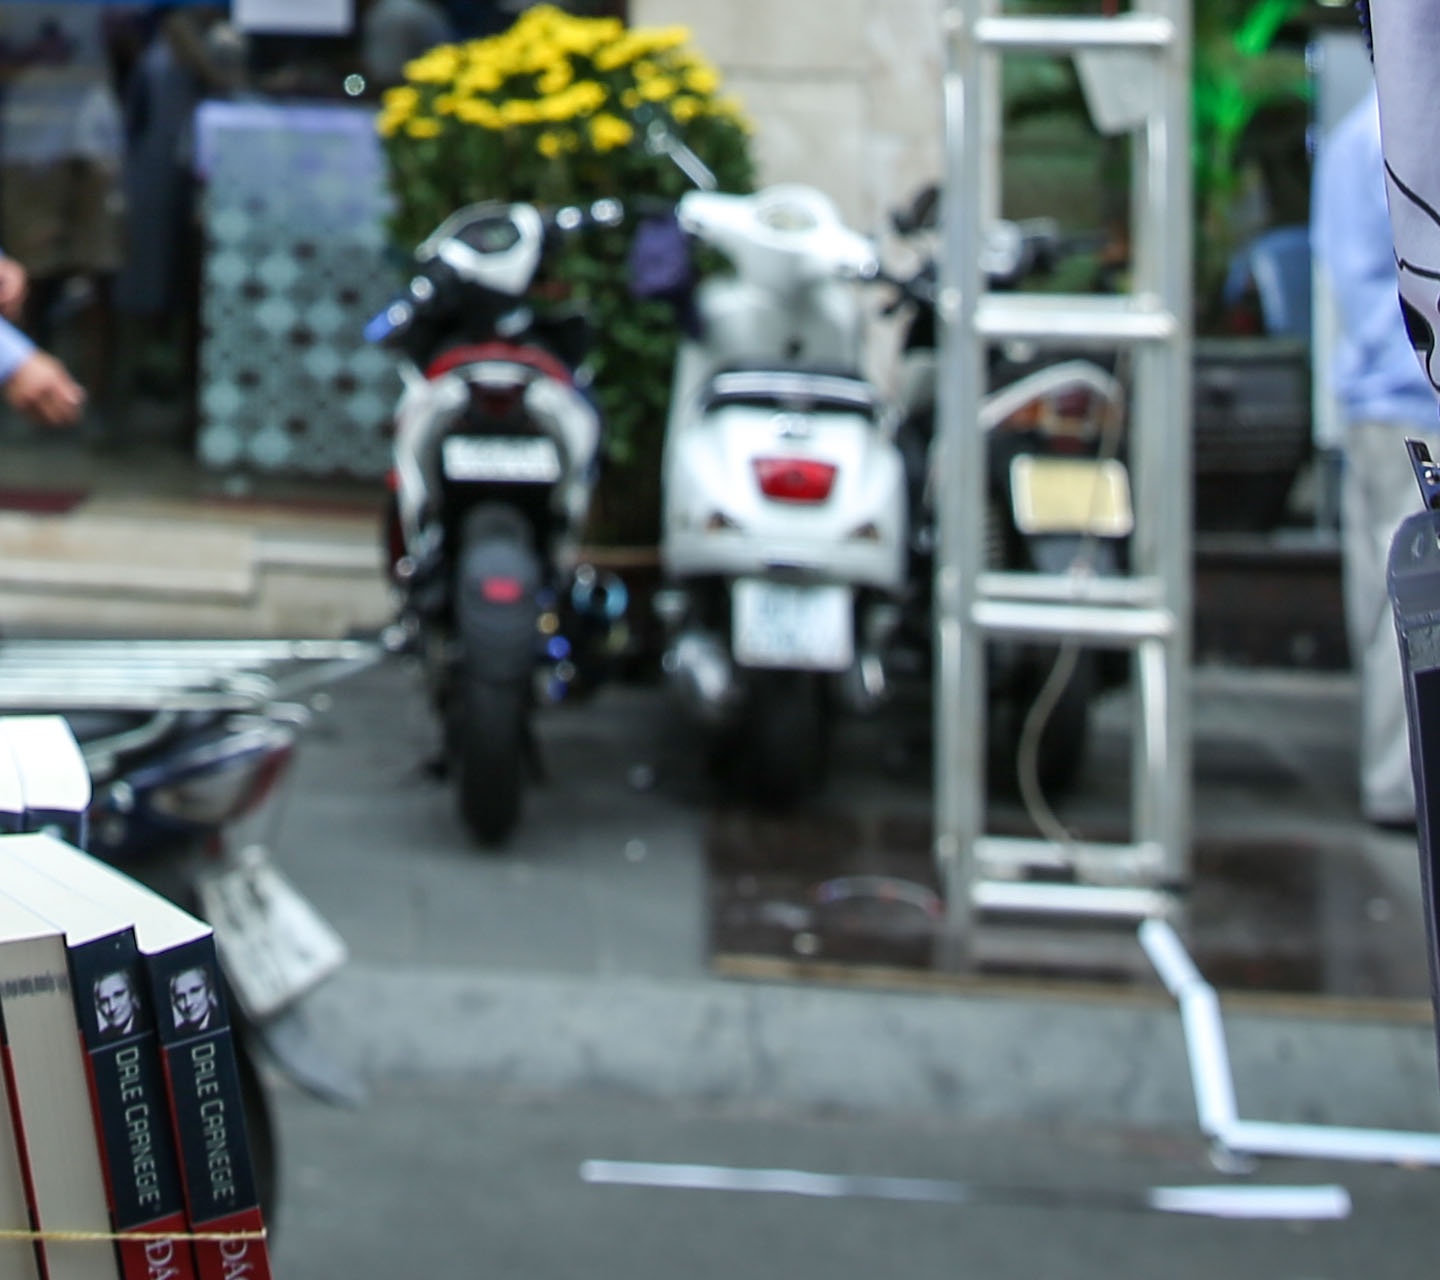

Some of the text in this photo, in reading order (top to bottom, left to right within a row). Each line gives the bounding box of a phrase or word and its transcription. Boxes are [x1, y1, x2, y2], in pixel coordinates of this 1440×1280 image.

[115, 1045, 161, 1207] DALE CARNEGIE
[190, 1042, 235, 1201] DALE CARNEGIE
